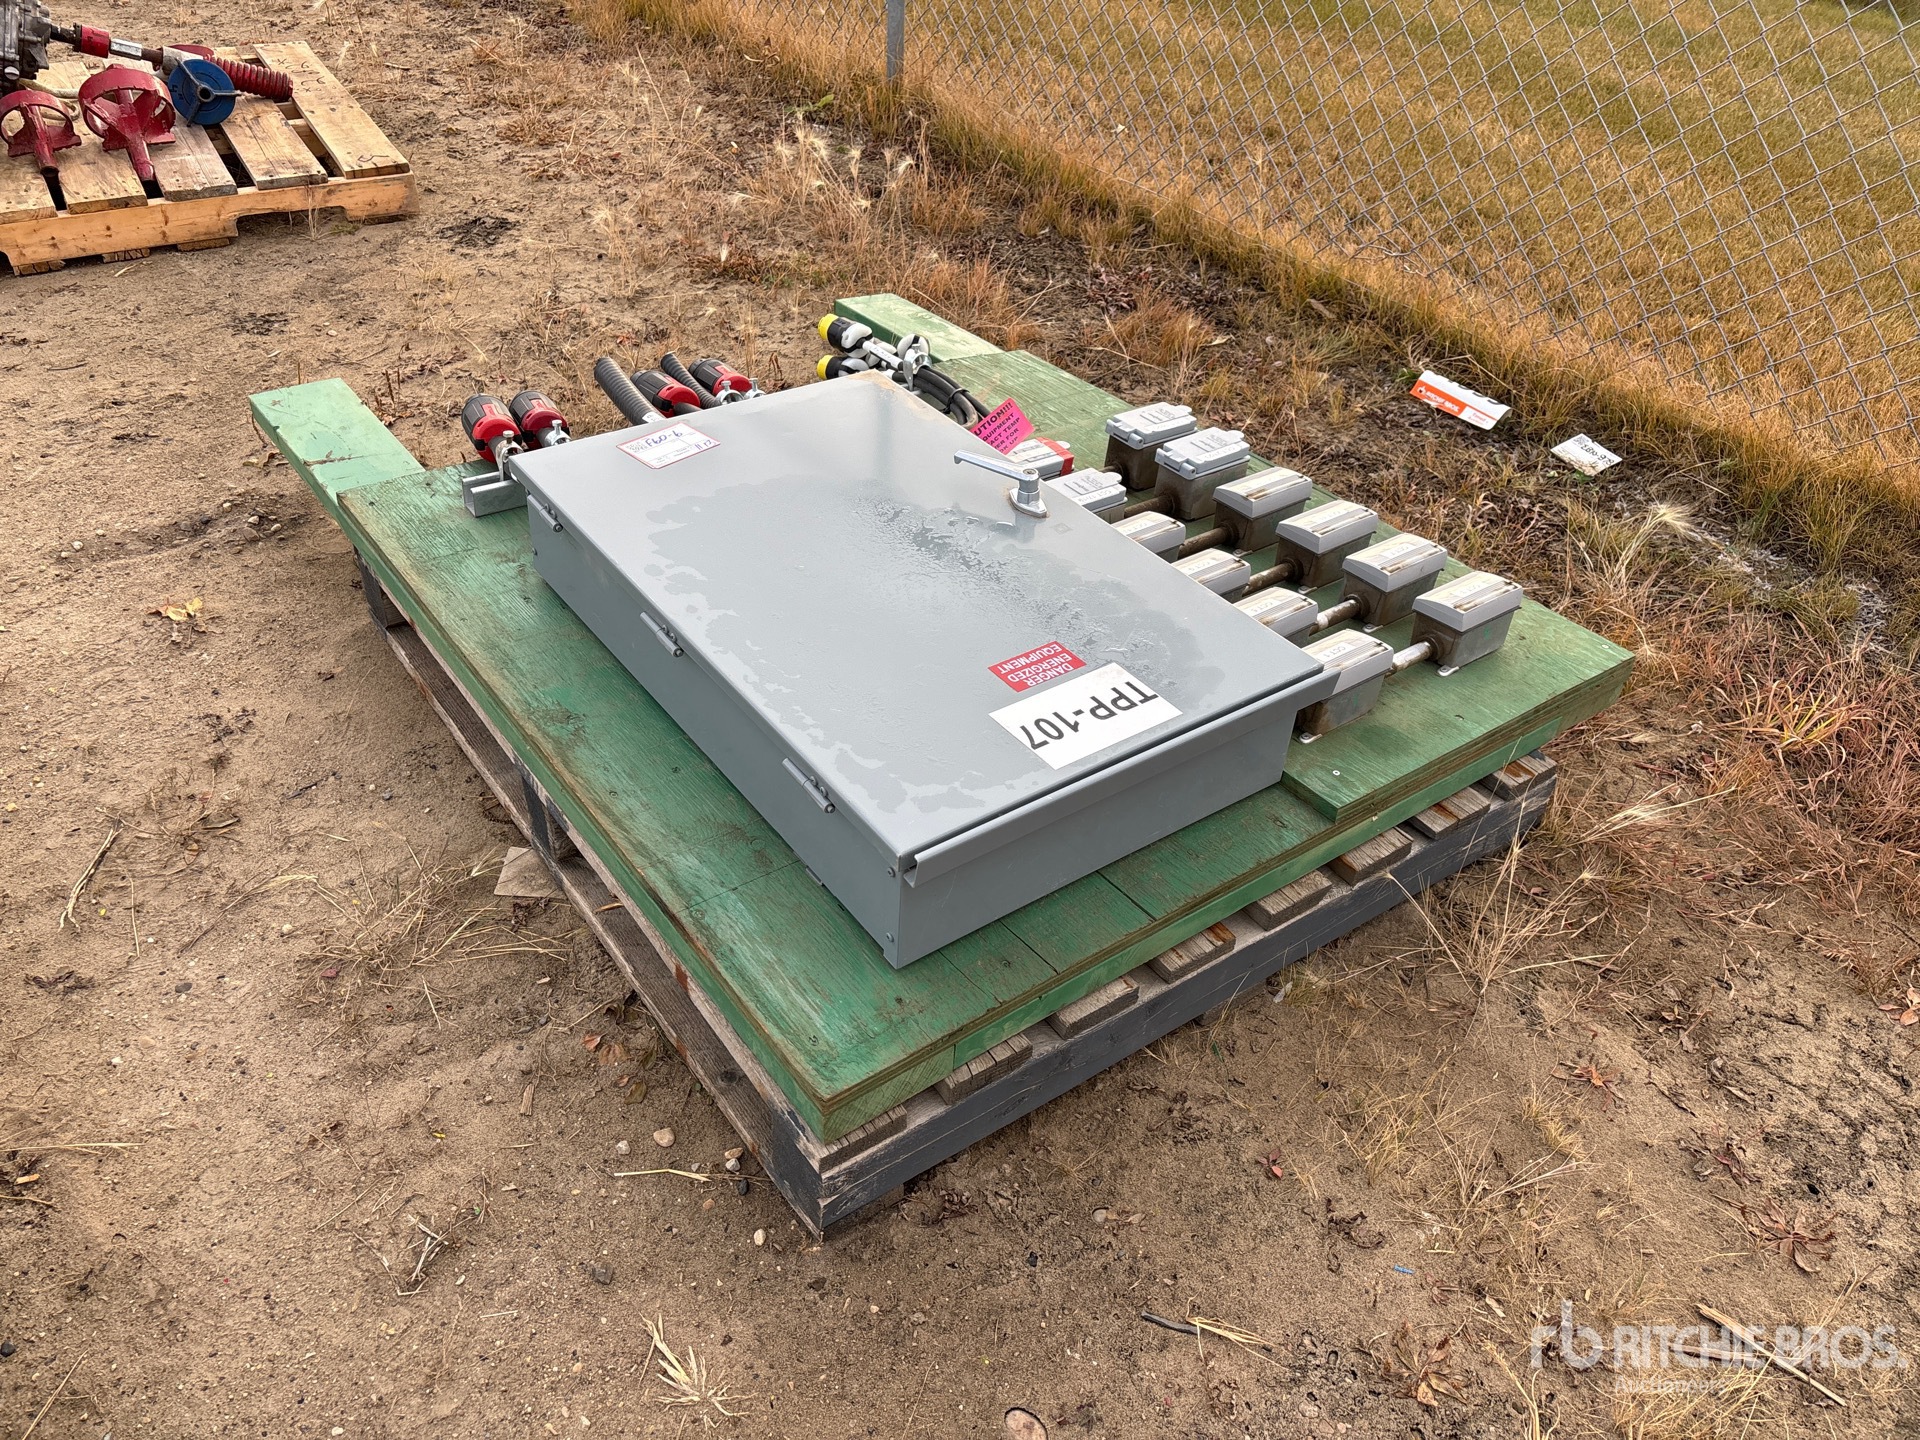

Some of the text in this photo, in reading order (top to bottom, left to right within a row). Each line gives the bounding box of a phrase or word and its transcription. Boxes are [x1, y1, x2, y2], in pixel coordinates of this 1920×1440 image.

[987, 417, 1020, 445] ACT TEMP
[1006, 428, 1019, 440] FOR
[1009, 436, 1018, 445] UP
[997, 644, 1062, 674] EQUIPMENT
[1007, 653, 1073, 683] ENERGIZED
[1023, 663, 1074, 687] DANGER
[1019, 681, 1159, 750] TPP-107
